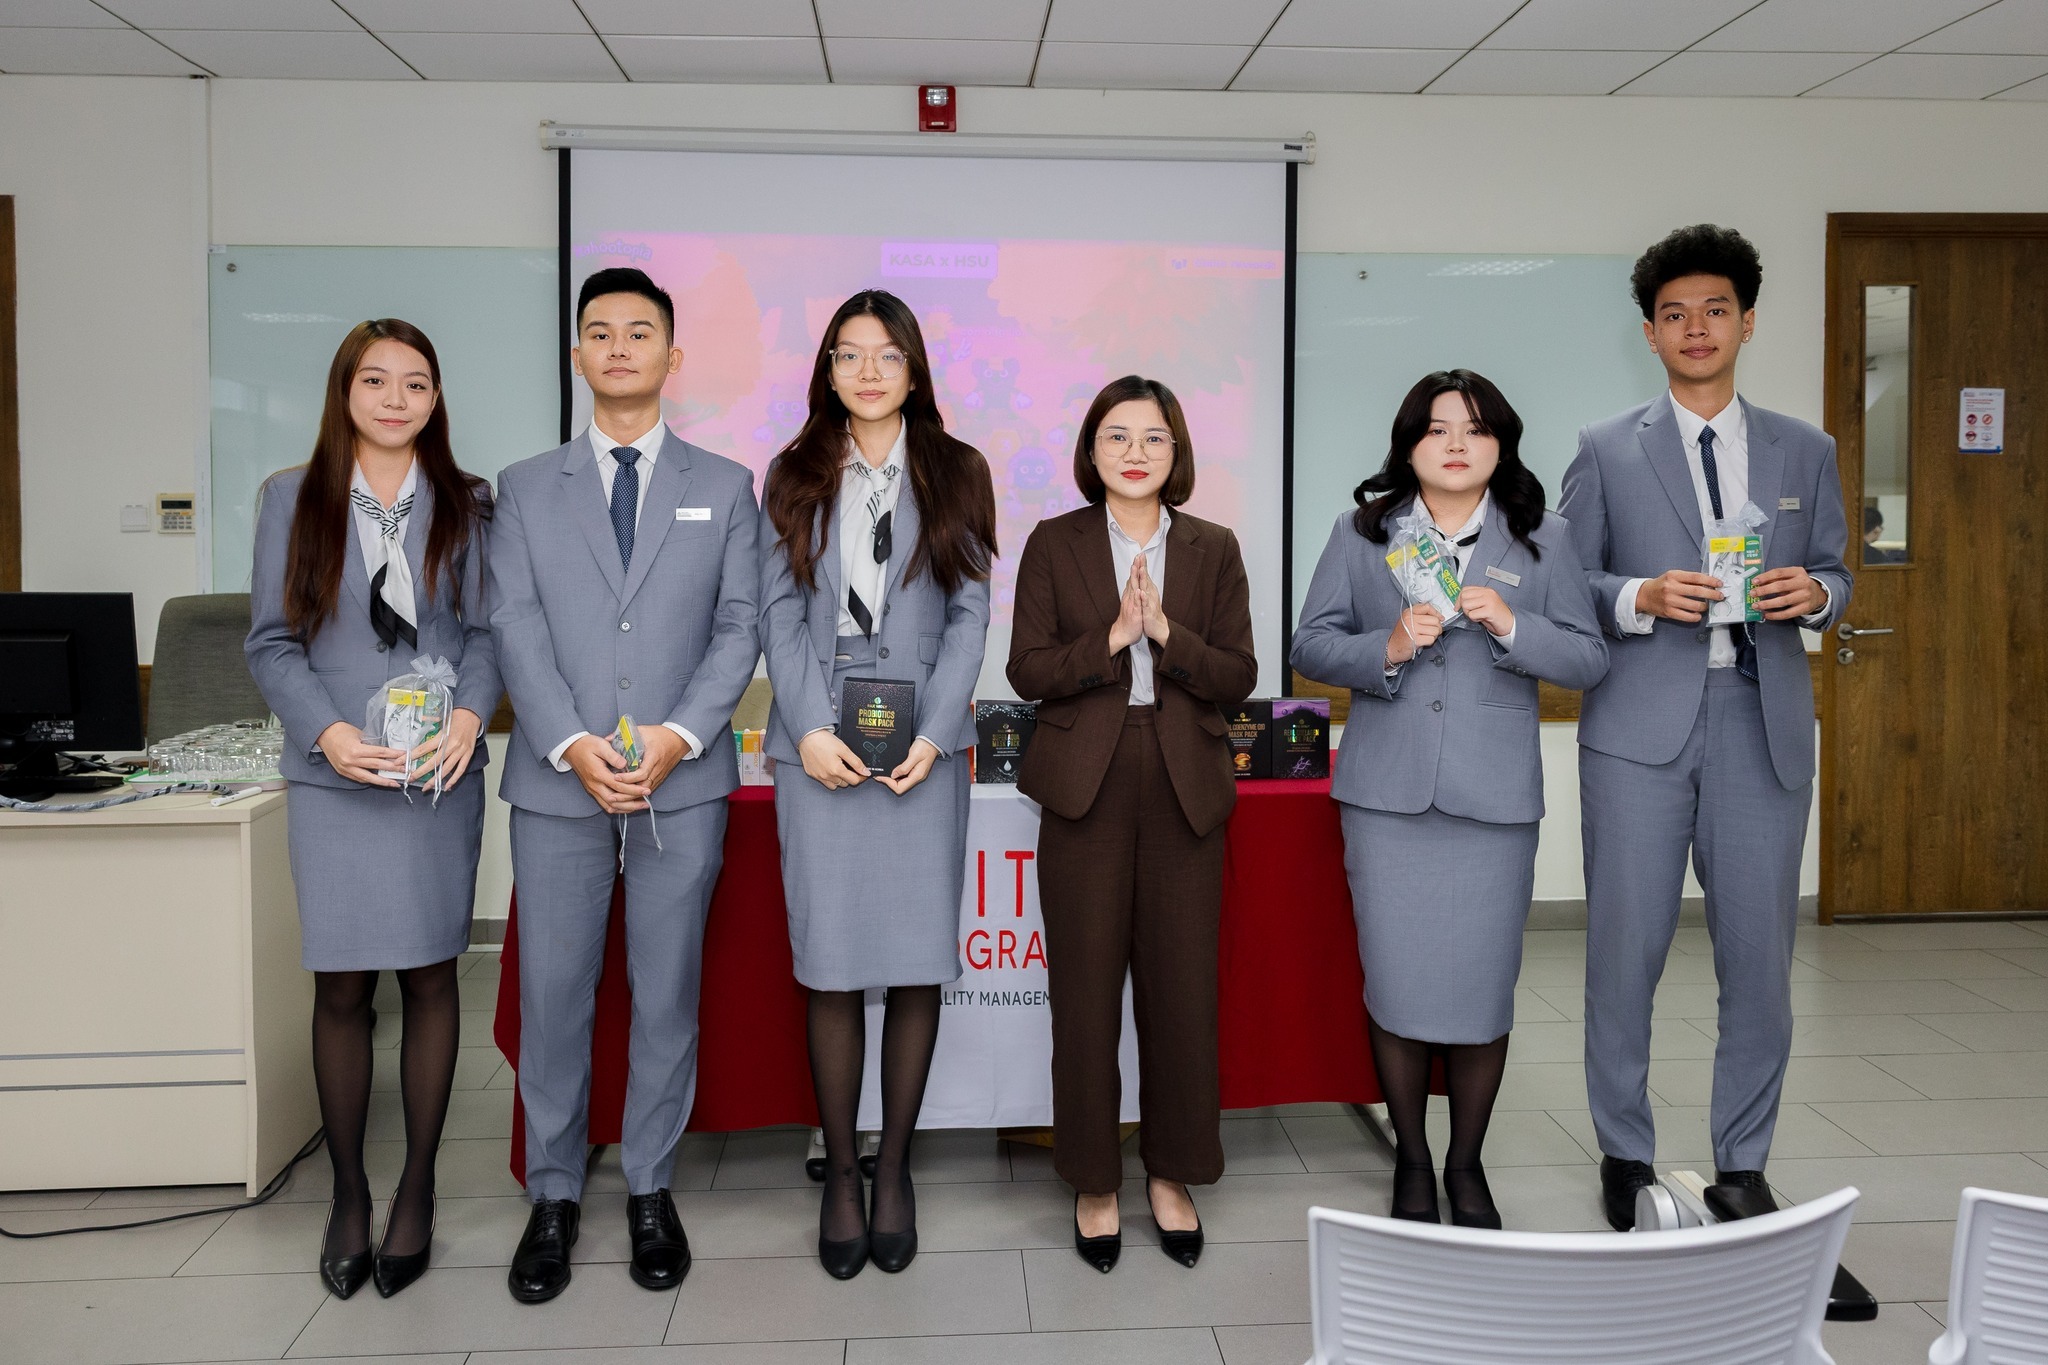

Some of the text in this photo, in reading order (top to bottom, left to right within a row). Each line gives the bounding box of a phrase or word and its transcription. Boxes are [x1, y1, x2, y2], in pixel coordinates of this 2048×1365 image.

[890, 254, 935, 266] KASA
[955, 256, 989, 267] HSU
[858, 709, 895, 719] PROBIOTICS
[858, 718, 894, 728] MASK PACK
[957, 929, 1048, 970] GRA
